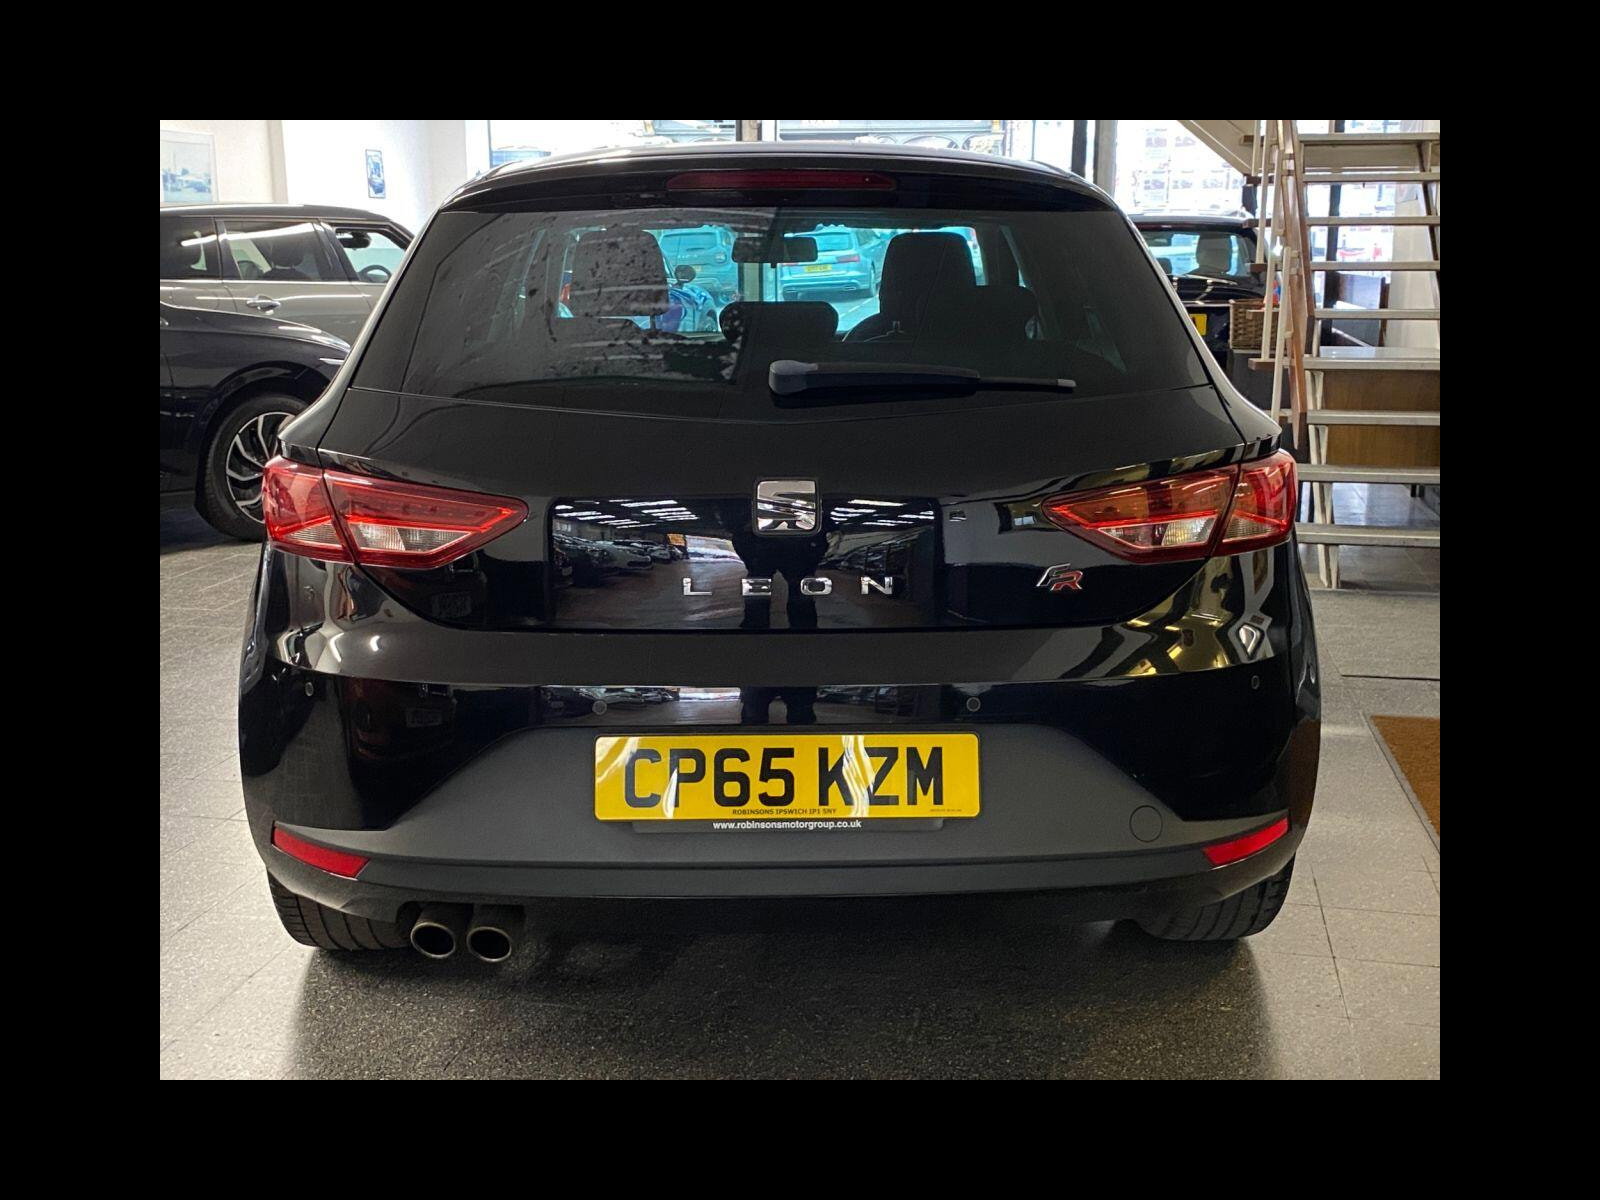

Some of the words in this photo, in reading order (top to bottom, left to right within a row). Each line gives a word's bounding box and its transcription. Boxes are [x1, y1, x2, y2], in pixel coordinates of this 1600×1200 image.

[682, 576, 894, 596] LEON
[623, 747, 795, 809] CP65
[818, 746, 944, 807] KZM
[712, 819, 862, 830] www.robinsonsmotorgroup.co.uk
